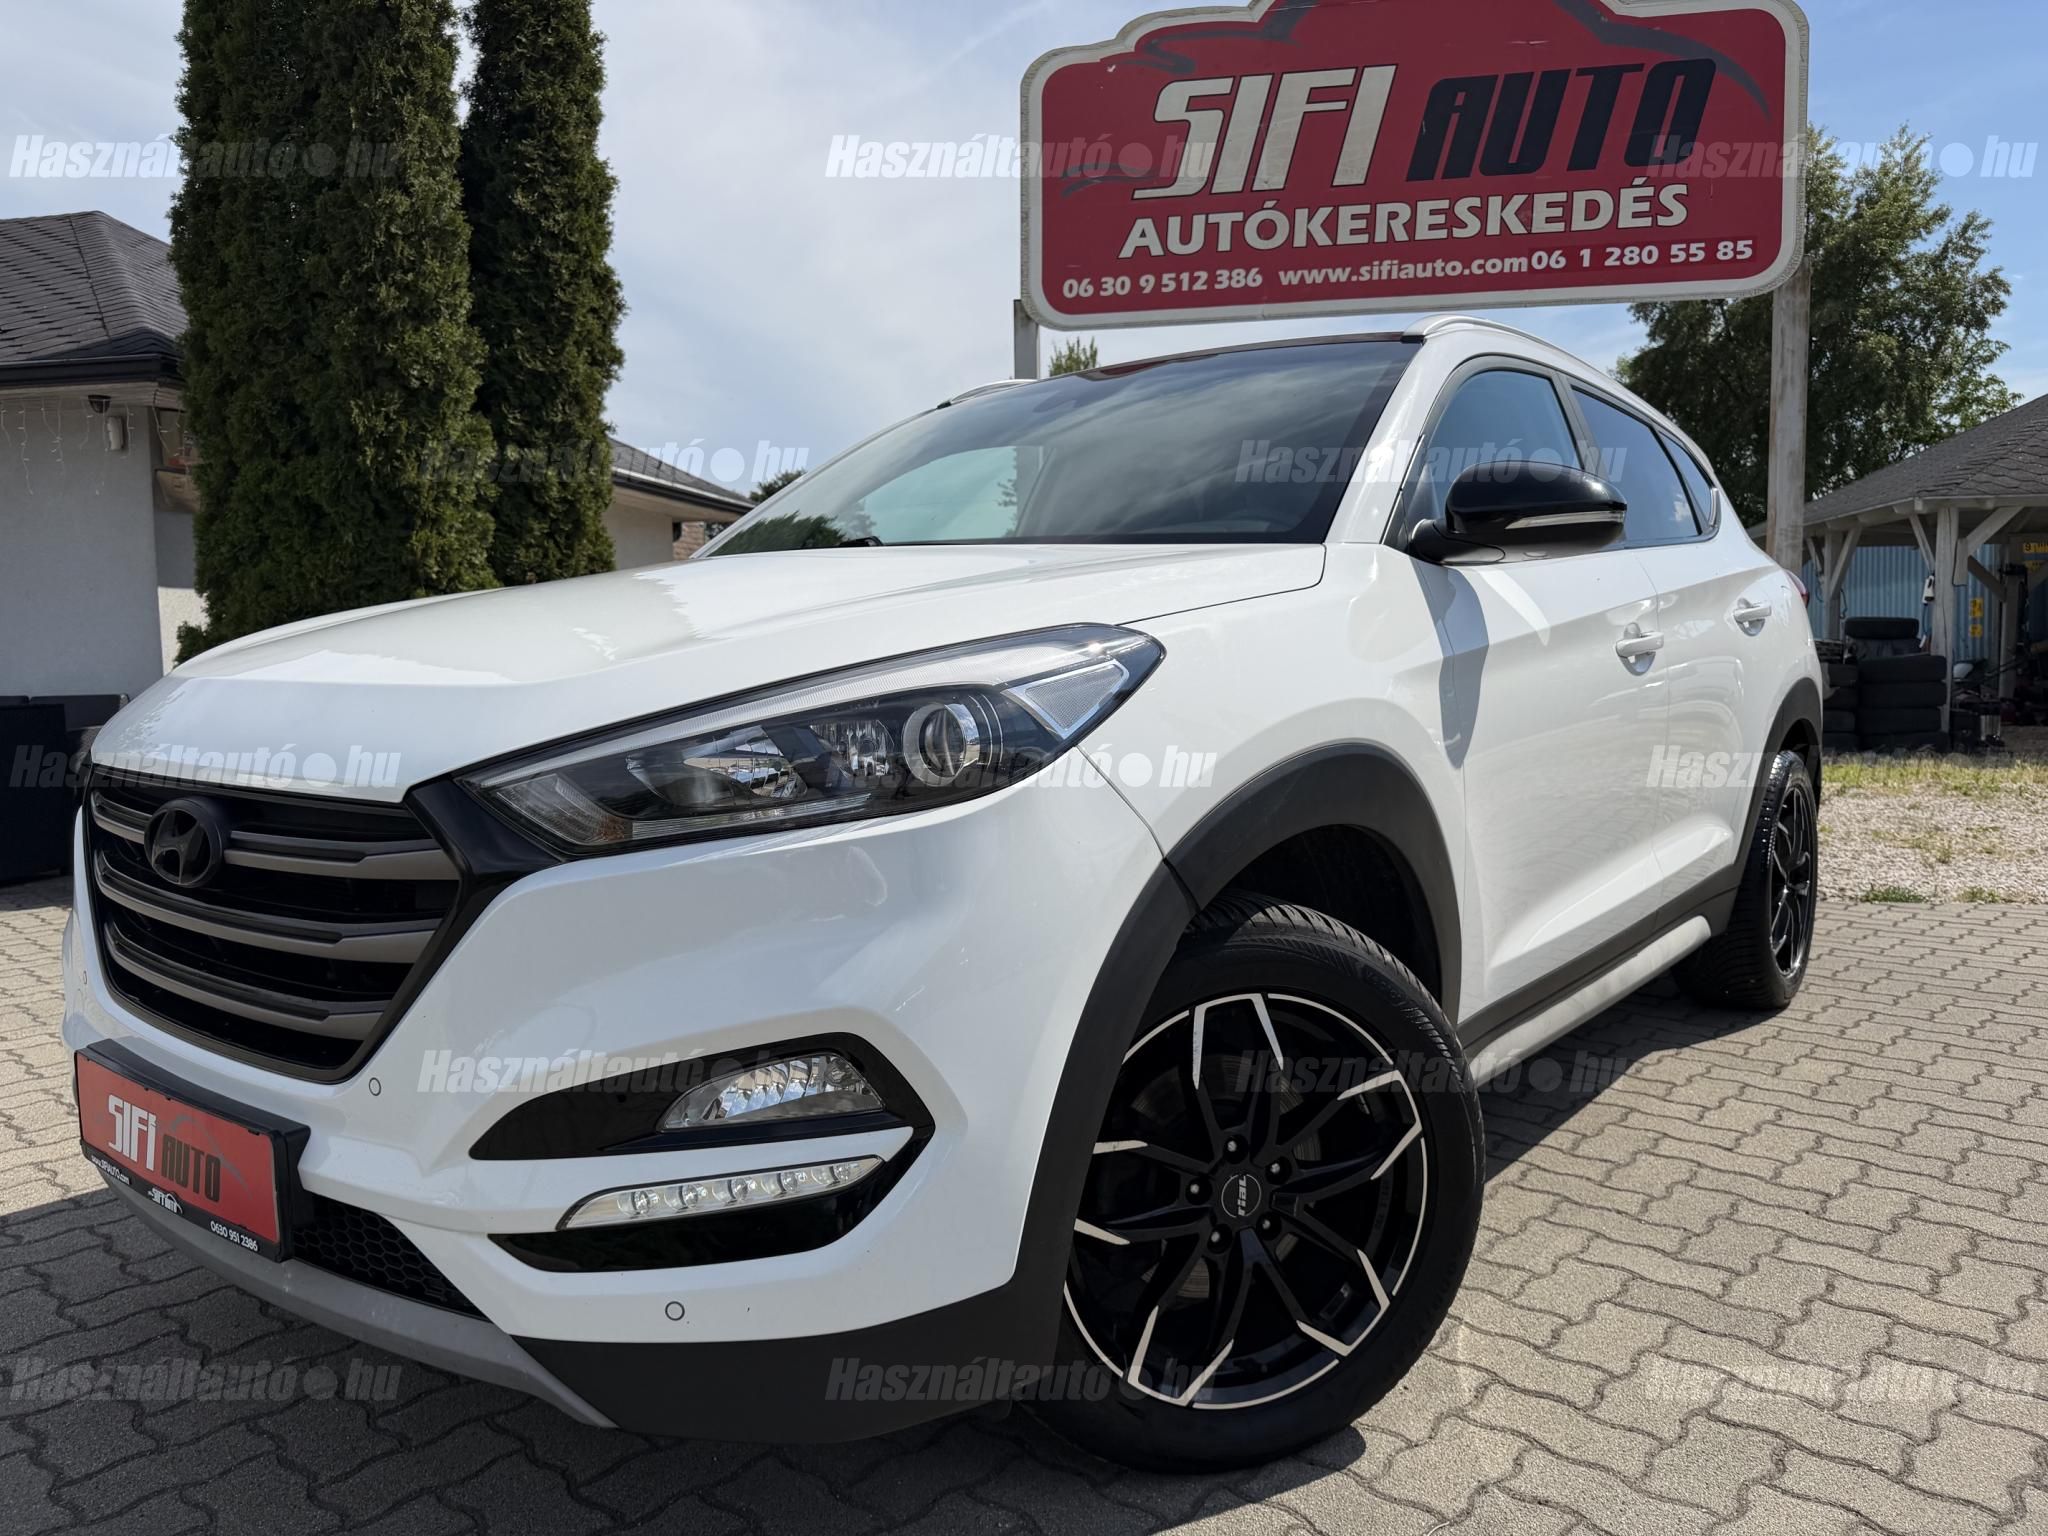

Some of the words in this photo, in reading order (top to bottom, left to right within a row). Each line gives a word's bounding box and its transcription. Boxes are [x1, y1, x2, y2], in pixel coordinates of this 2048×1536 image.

[1132, 64, 1397, 200] SIFI
[1405, 58, 1717, 182] AUTO
[1118, 176, 1690, 261] AUTÓKERESKEDÉS
[1530, 250, 1567, 271] 06
[1579, 248, 1592, 268] 1
[1603, 246, 1660, 267] 280
[1669, 242, 1706, 264] 55
[1716, 239, 1754, 260] 85
[1062, 278, 1095, 299] 06
[1099, 275, 1132, 297] 30
[1138, 273, 1156, 294] 9
[1160, 271, 1209, 293] 512
[1214, 267, 1263, 290] 386
[1278, 254, 1528, 287] www.sifiauto.com
[108, 1094, 157, 1172] SIFI
[161, 1133, 222, 1204] AUTO
